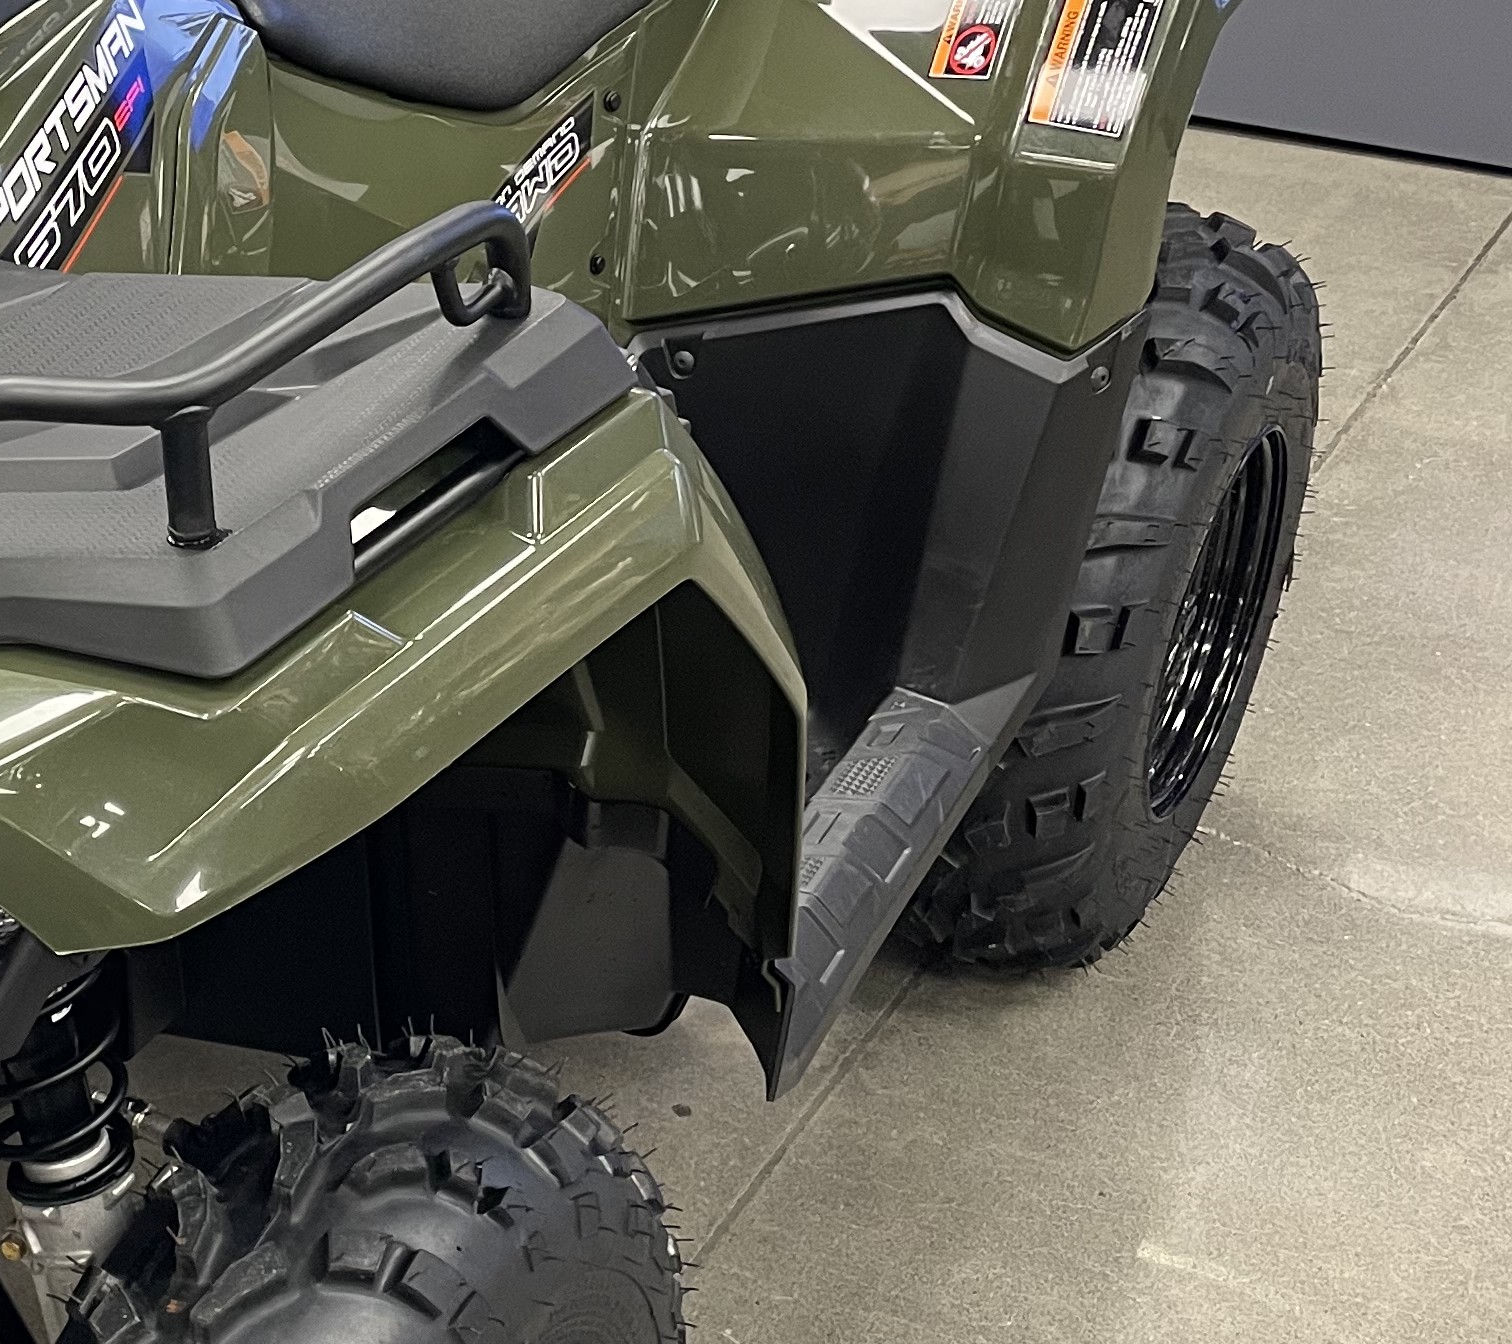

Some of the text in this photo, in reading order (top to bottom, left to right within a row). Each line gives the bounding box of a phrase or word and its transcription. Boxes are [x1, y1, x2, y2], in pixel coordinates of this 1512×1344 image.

[1050, 10, 1080, 73] WARNING
[114, 75, 145, 132] EFI
[13, 117, 122, 270] 570
[506, 132, 581, 224] AWD
